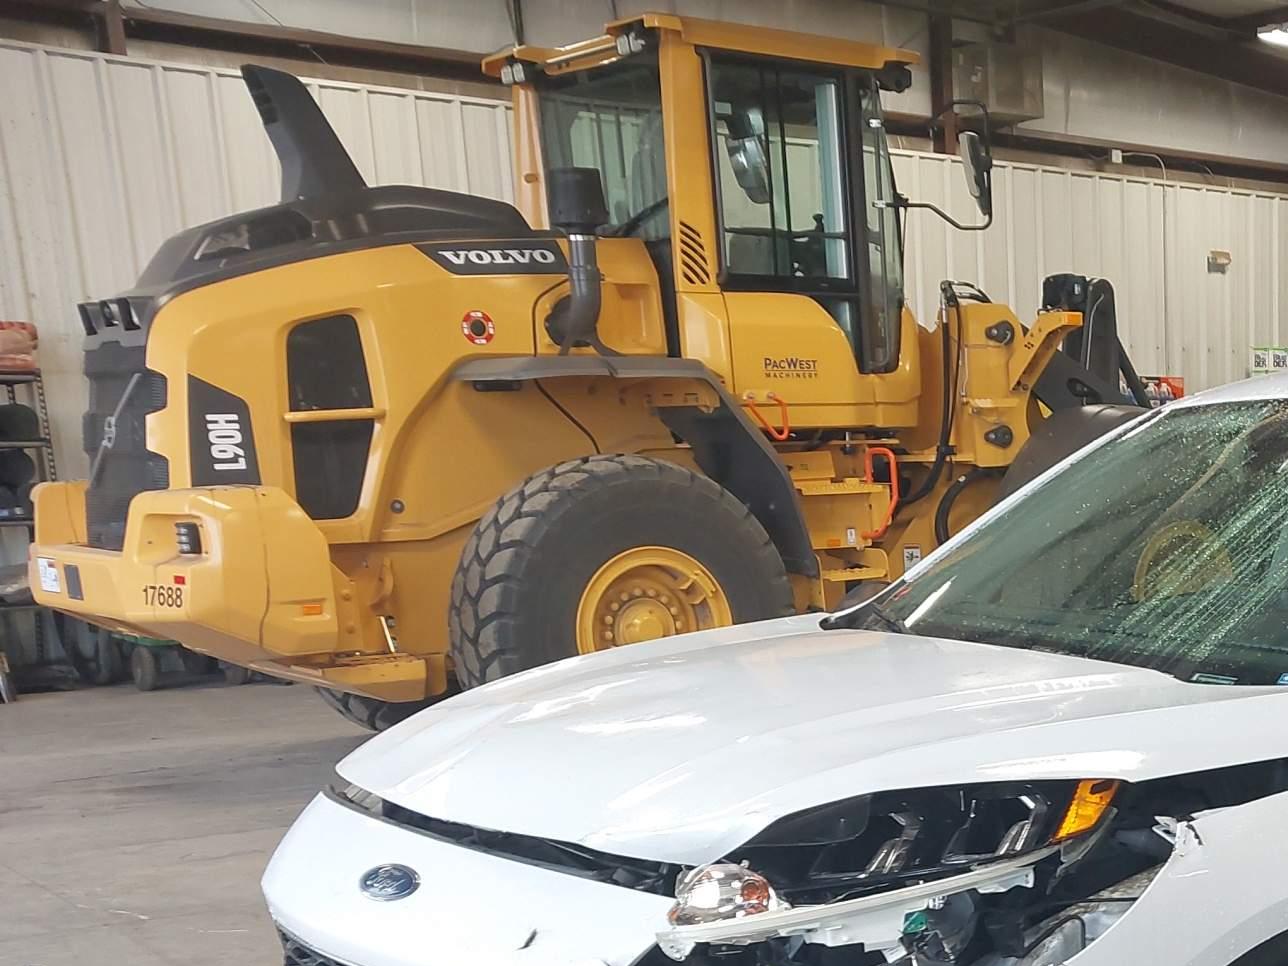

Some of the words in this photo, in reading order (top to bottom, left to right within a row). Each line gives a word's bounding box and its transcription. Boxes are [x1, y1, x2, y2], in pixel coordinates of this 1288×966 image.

[438, 249, 556, 265] VOLVO
[204, 413, 247, 470] L90H
[142, 585, 183, 608] 17688
